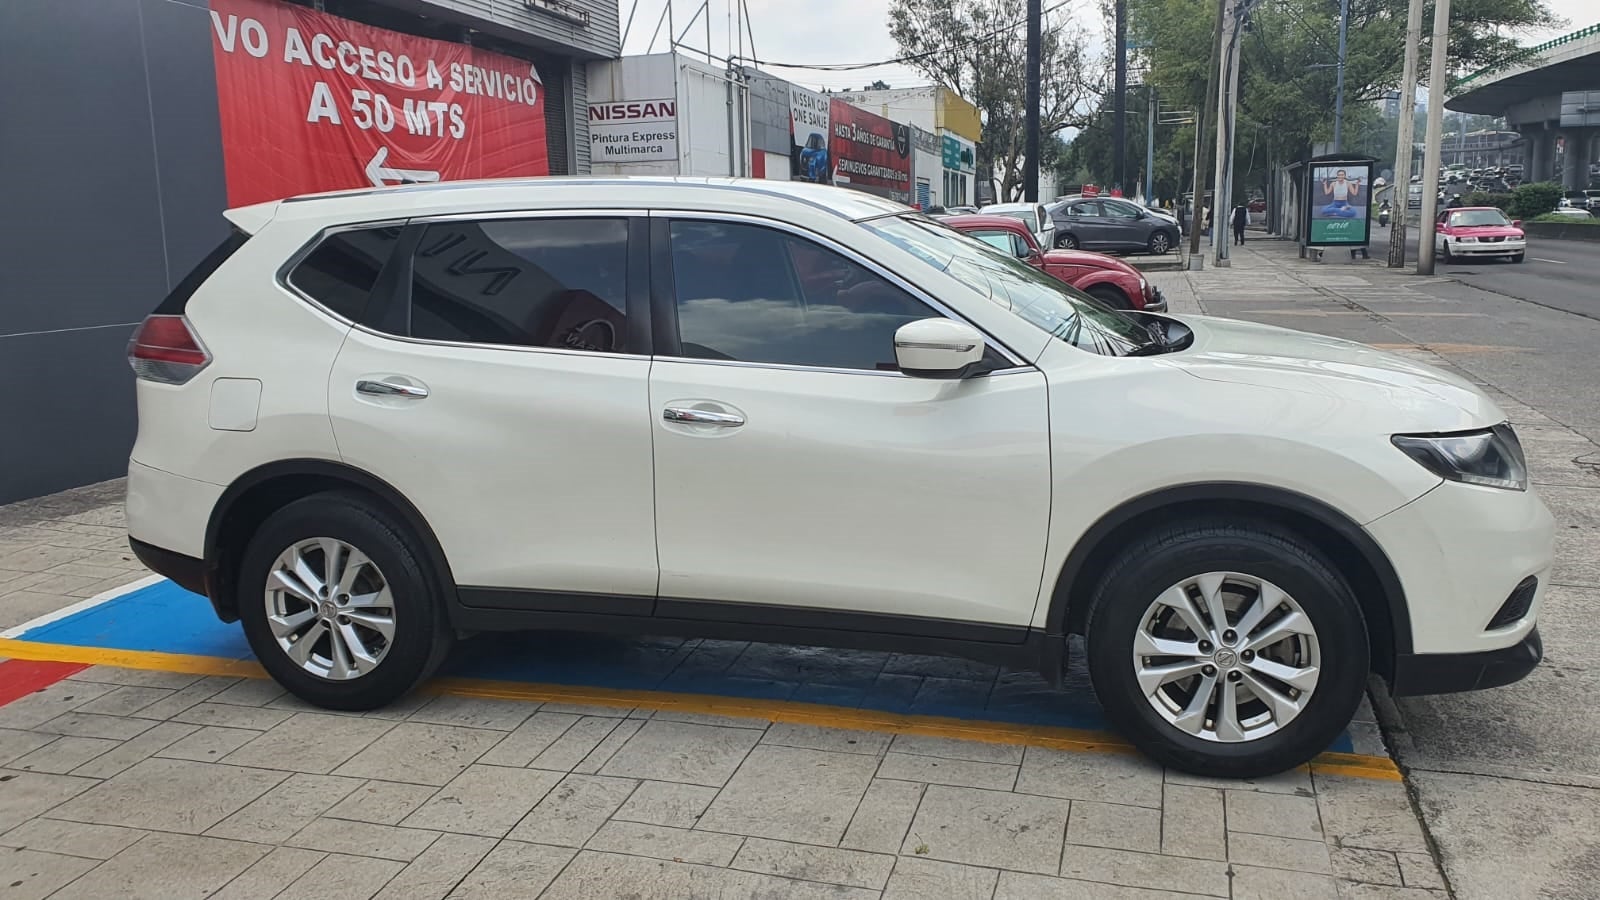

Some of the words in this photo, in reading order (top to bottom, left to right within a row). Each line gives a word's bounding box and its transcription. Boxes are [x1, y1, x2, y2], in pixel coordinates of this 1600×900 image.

[210, 10, 269, 58] VO
[284, 28, 416, 88] ACCESO
[427, 59, 443, 90] A
[449, 62, 537, 106] SERVICIO
[307, 81, 341, 125] A
[352, 89, 395, 133] 50
[403, 98, 465, 139] MTS
[588, 102, 675, 121] NISSAN
[792, 89, 816, 110] NISSAN
[817, 99, 829, 115] CAR
[794, 107, 808, 124] ONE
[808, 112, 828, 129] SANJE
[592, 133, 629, 144] Pintura
[632, 132, 675, 143] Express
[834, 123, 851, 140] HASTA
[851, 121, 857, 141] 3
[605, 144, 663, 155] Multimarca
